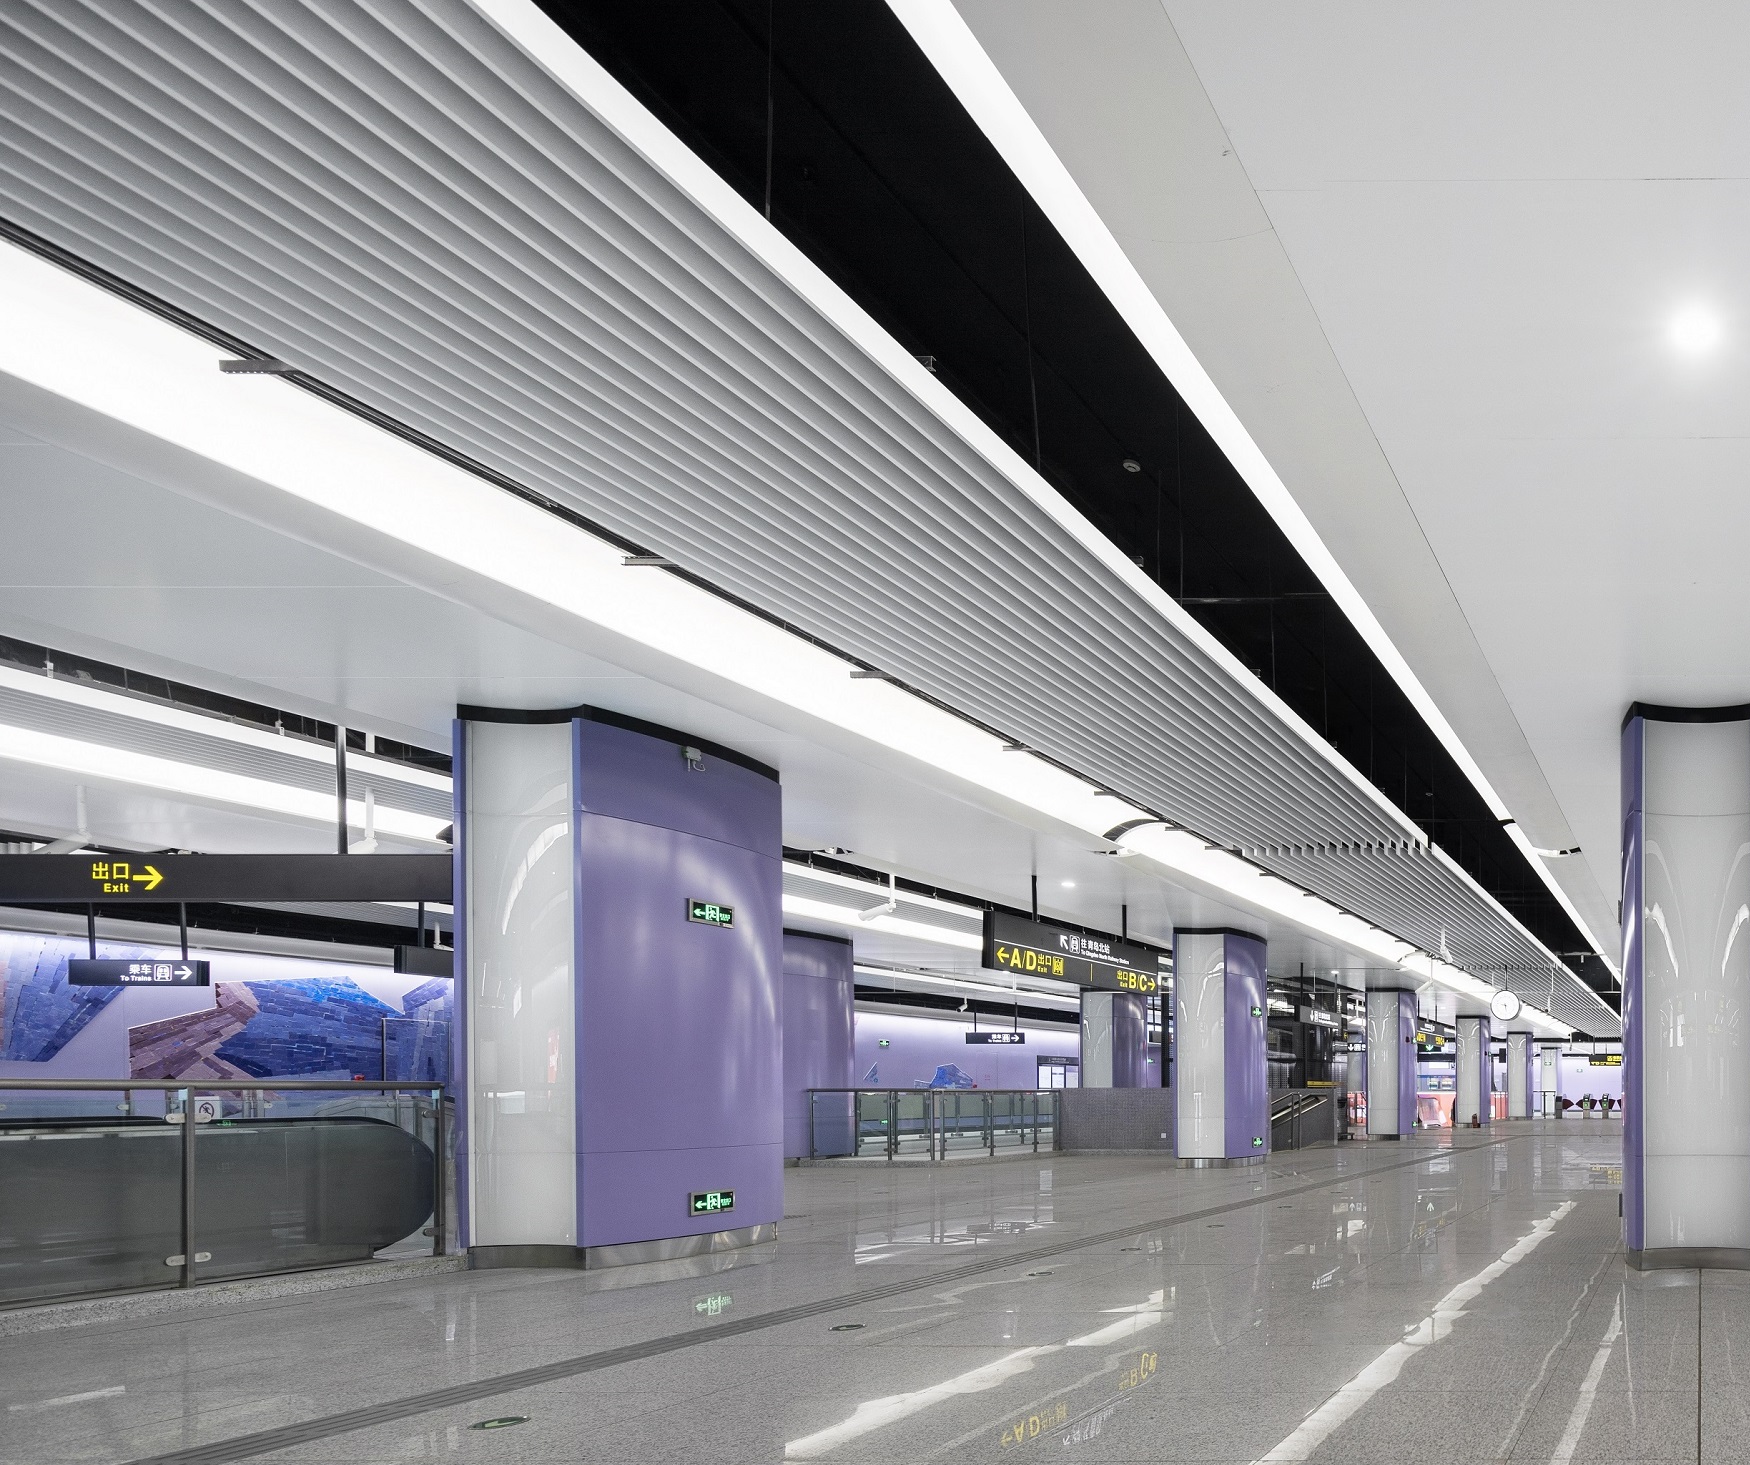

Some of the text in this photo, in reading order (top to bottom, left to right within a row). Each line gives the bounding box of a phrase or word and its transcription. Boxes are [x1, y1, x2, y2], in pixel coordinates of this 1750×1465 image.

[92, 861, 129, 880] 出口
[103, 883, 129, 893] Exit
[1010, 947, 1037, 971] A/D
[1037, 953, 1052, 966] 出口
[129, 963, 152, 975] 乘车
[1116, 969, 1129, 981] 出口
[1128, 971, 1148, 992] B/C
